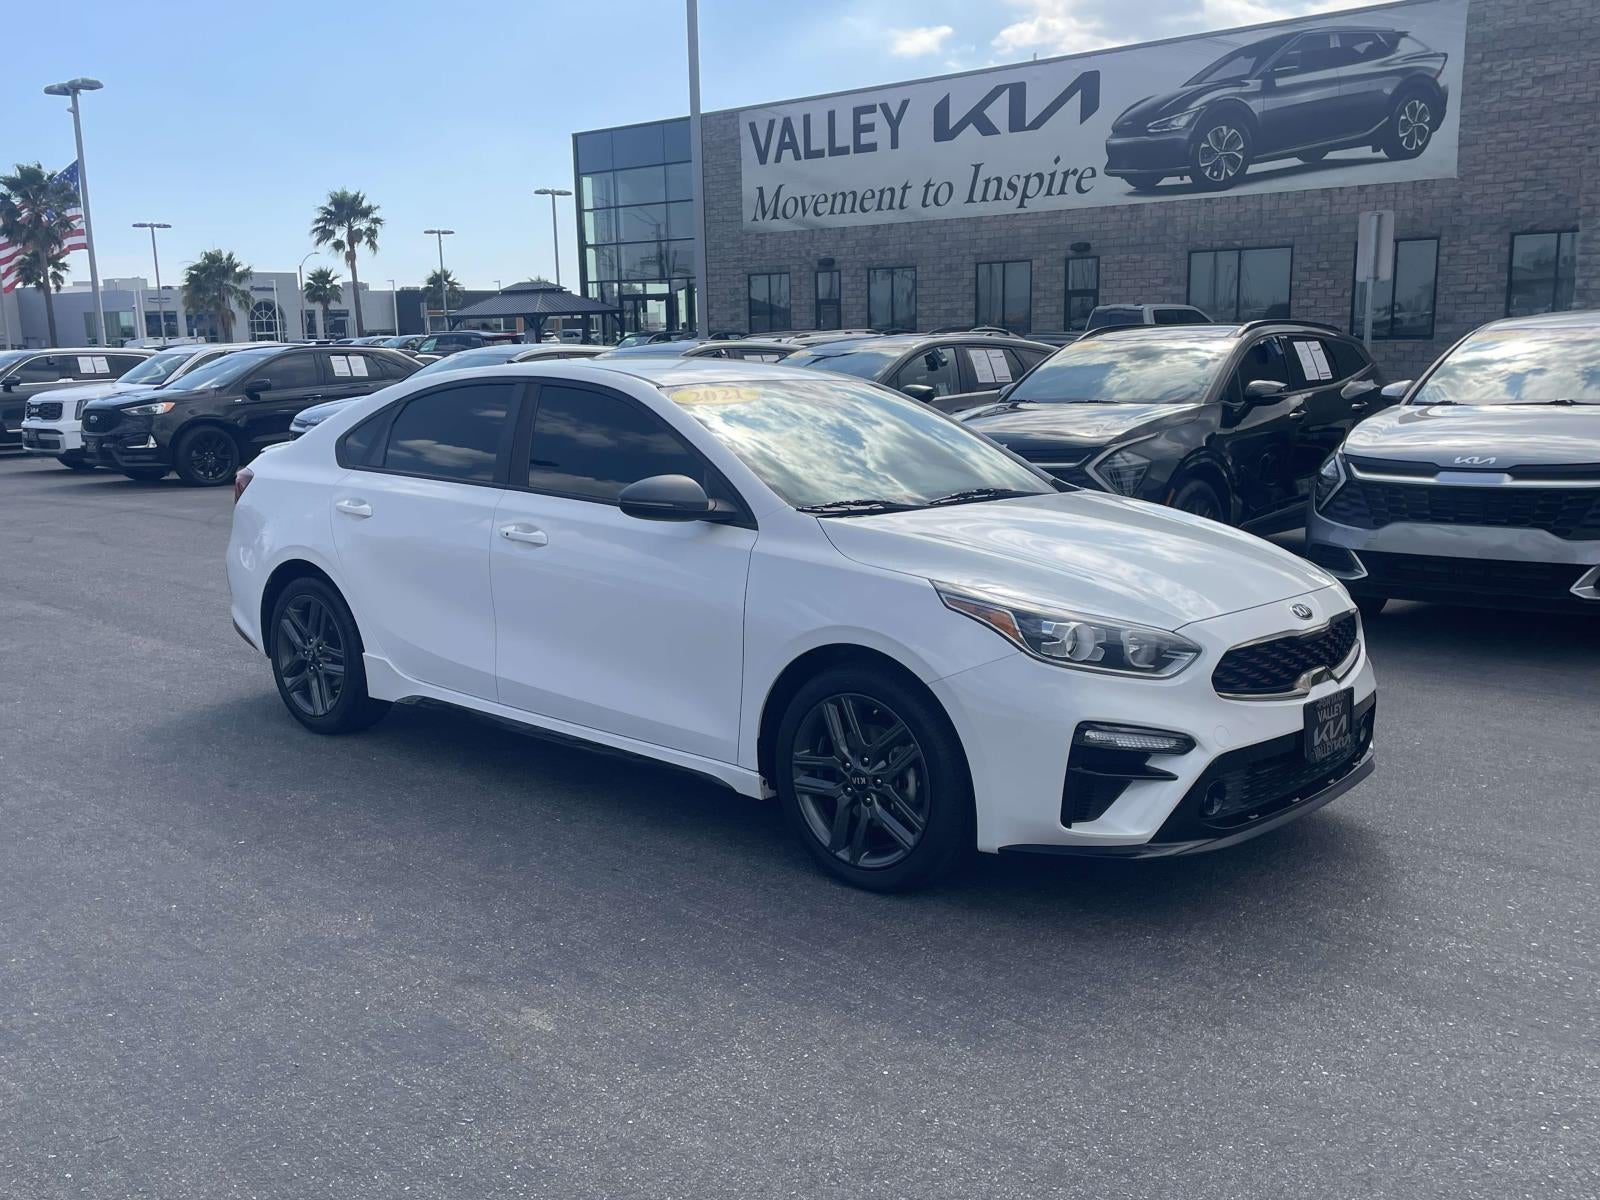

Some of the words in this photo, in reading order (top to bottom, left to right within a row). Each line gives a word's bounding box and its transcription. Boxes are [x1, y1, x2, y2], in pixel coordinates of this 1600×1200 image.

[748, 98, 911, 165] VALLEY
[933, 70, 1100, 143] KIA
[751, 180, 912, 222] Movement
[921, 178, 954, 208] to
[964, 155, 1097, 209] Inspire
[690, 388, 743, 401] 2021
[1454, 456, 1497, 465] KIA
[1317, 701, 1343, 723] VALLEY
[1313, 713, 1347, 747] KIA
